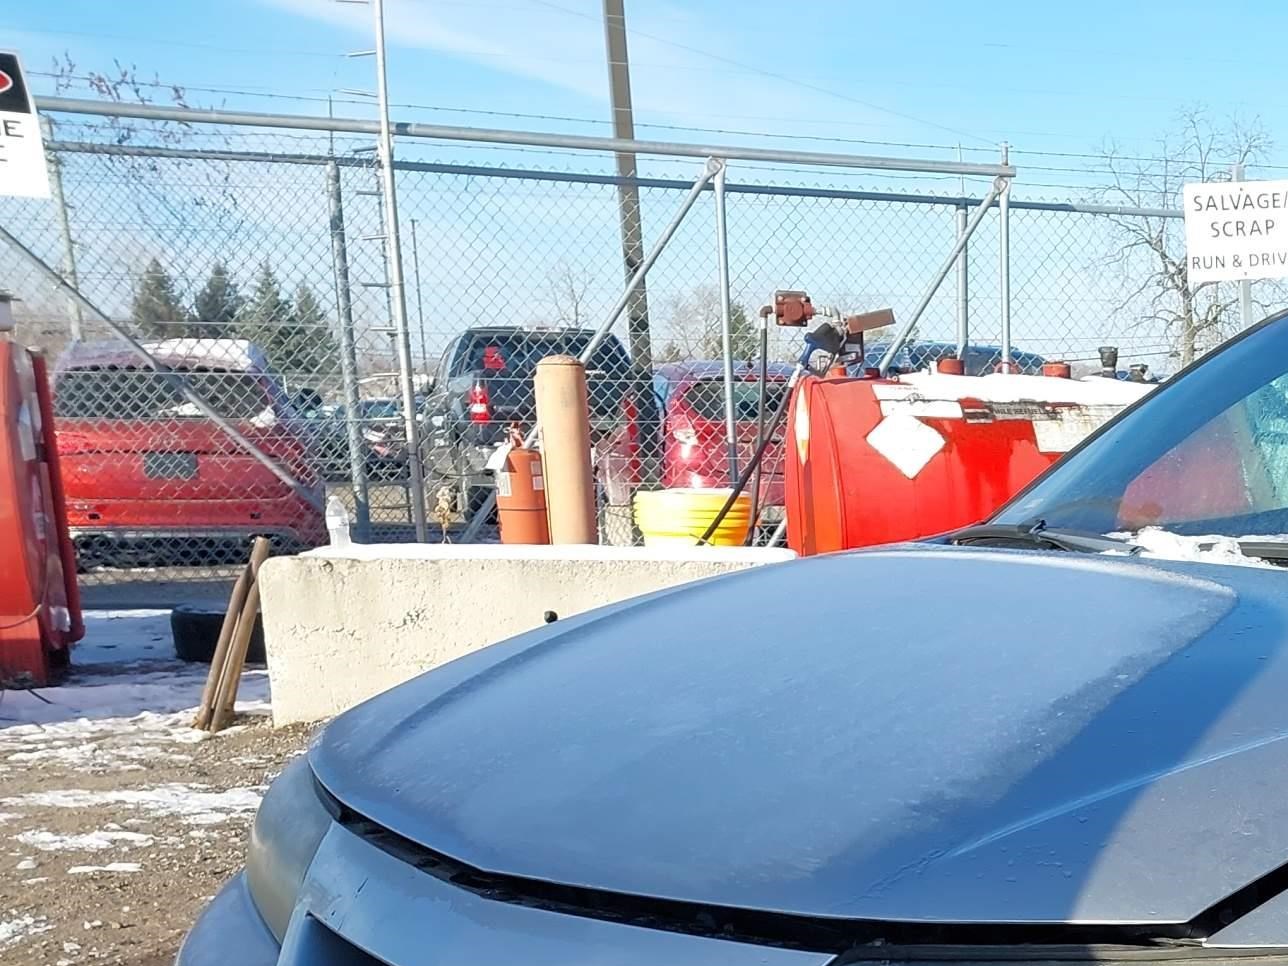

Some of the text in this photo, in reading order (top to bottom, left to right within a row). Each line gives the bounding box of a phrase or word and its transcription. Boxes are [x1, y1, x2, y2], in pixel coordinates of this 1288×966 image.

[1193, 191, 1288, 212] SALVAGE/
[1210, 219, 1275, 238] SCRAP
[1192, 255, 1226, 270] RUN
[1232, 254, 1243, 268] &
